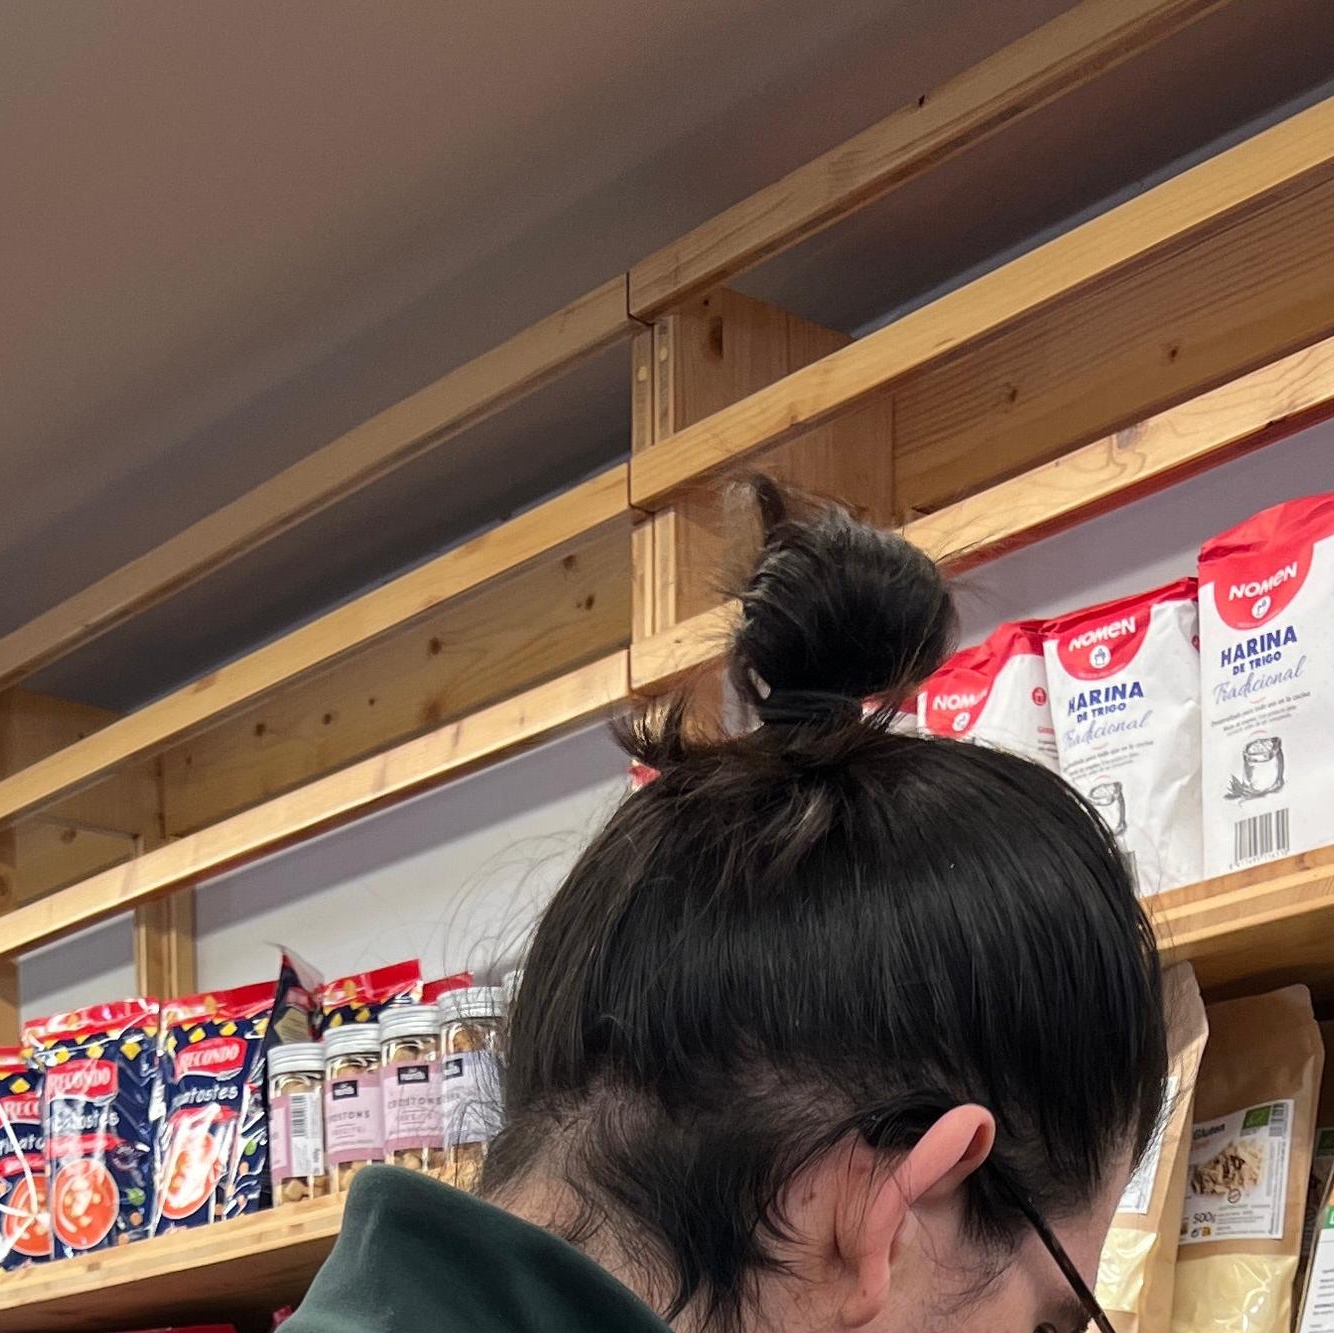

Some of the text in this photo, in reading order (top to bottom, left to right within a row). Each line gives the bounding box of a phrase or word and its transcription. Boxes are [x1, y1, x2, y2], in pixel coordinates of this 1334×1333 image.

[1220, 626, 1297, 668] HARINA
[1232, 651, 1282, 676] DE TRIGO
[1212, 655, 1307, 704] Tradicional
[1091, 702, 1127, 718] TRIGO
